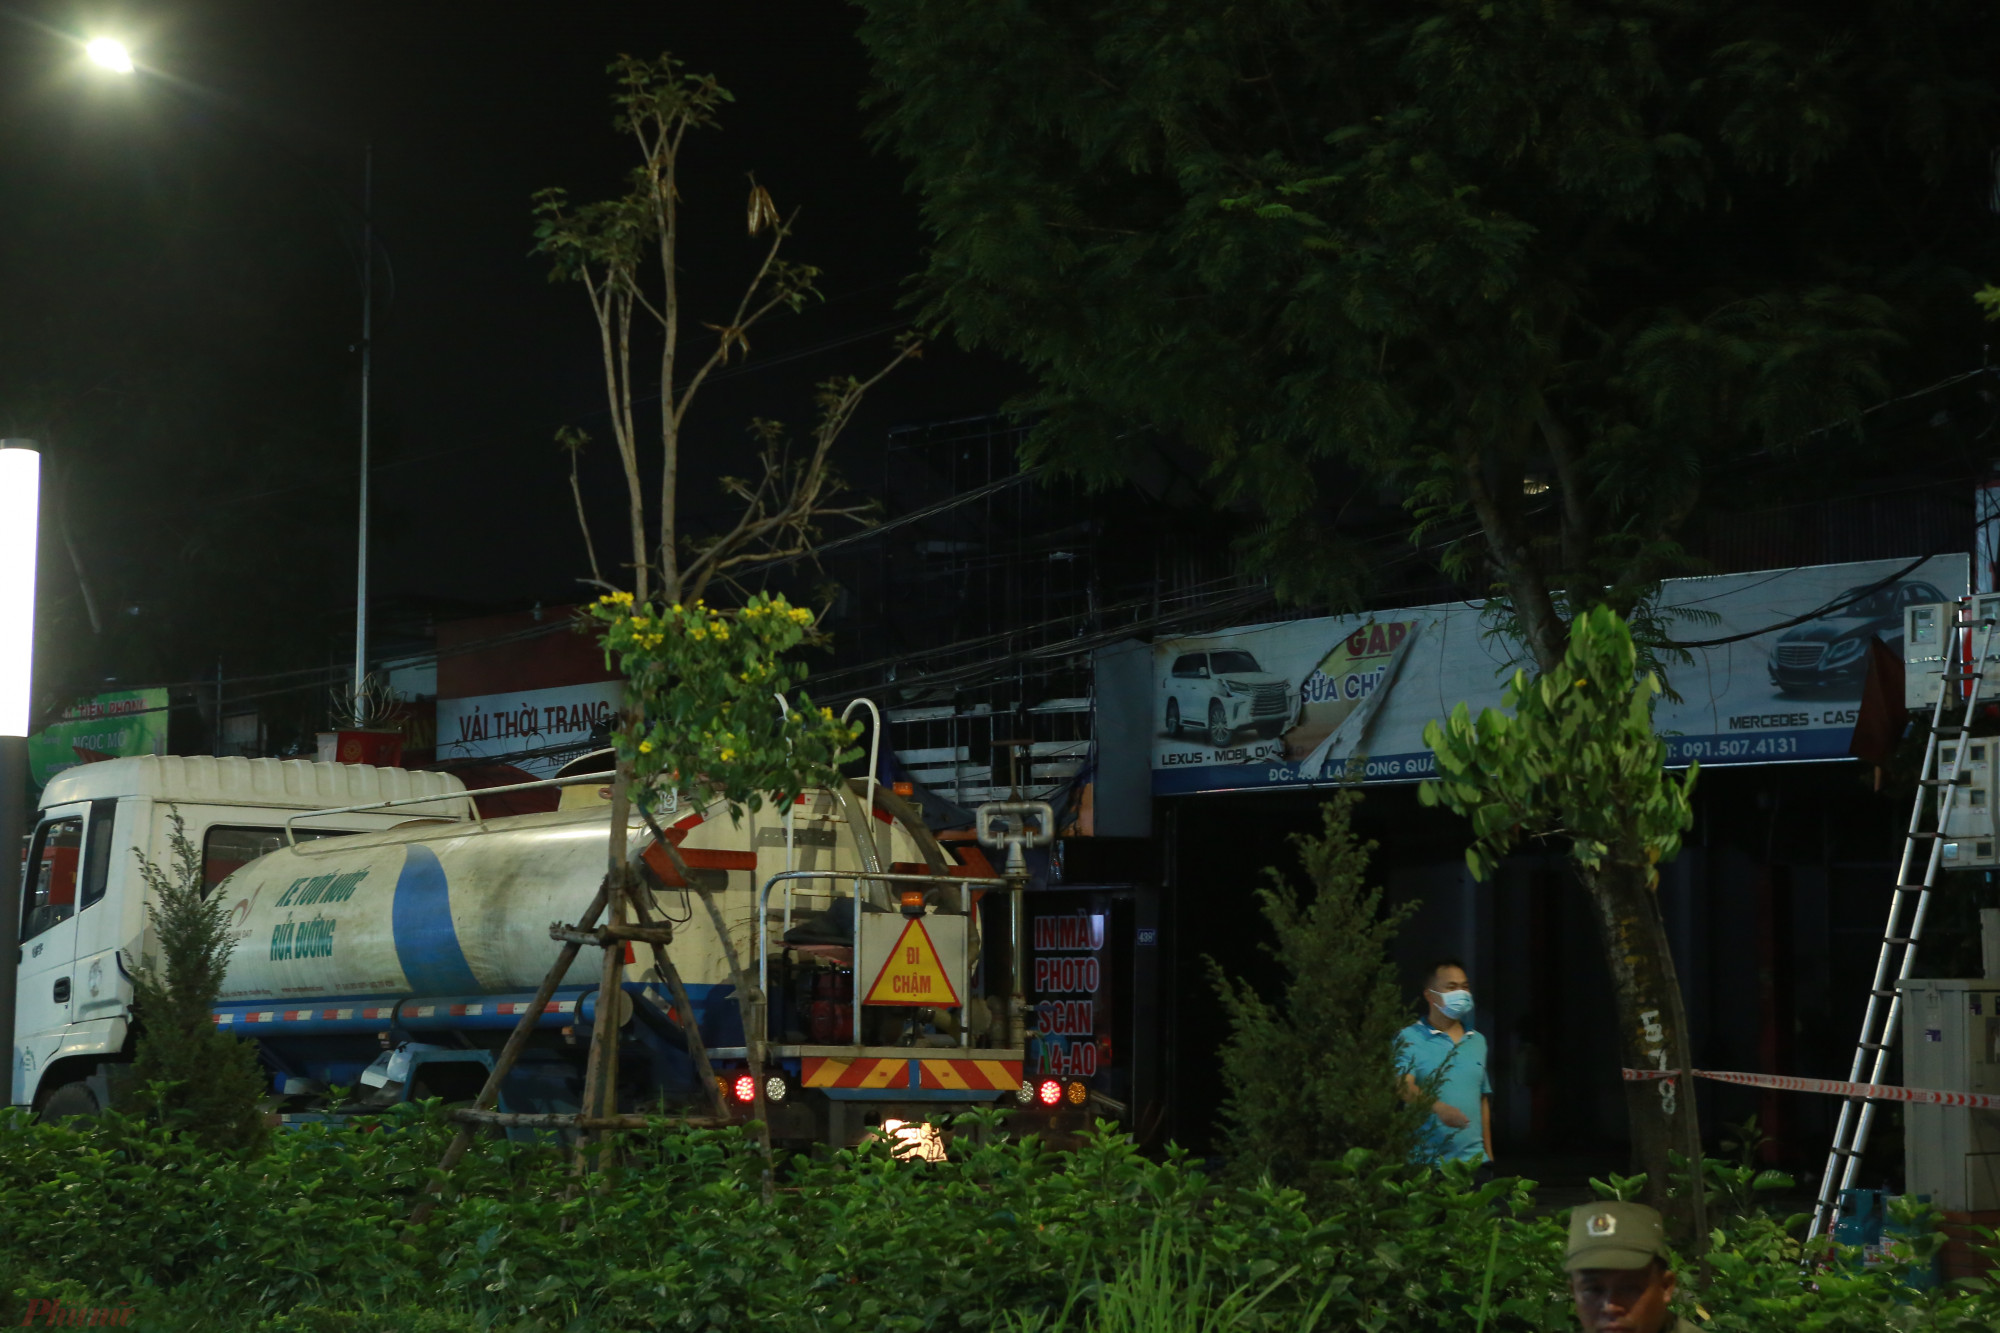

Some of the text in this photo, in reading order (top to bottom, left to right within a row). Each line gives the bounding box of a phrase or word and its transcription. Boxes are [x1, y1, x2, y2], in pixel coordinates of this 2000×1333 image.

[460, 706, 489, 742] VẢI
[494, 703, 538, 739] THỜI
[544, 701, 610, 735] TRANG
[1729, 713, 1809, 729] MERCEDES
[1162, 752, 1202, 765] LEXUS
[1215, 749, 1251, 762] MOBIL
[1683, 737, 1797, 757] 091.507.4131
[1269, 768, 1295, 782] ĐC:
[1035, 908, 1104, 950] IN MÀU
[906, 947, 920, 964] ĐI
[893, 972, 931, 997] CHẬM
[1035, 957, 1099, 992] PHOTO
[1038, 1000, 1093, 1035] SCAN
